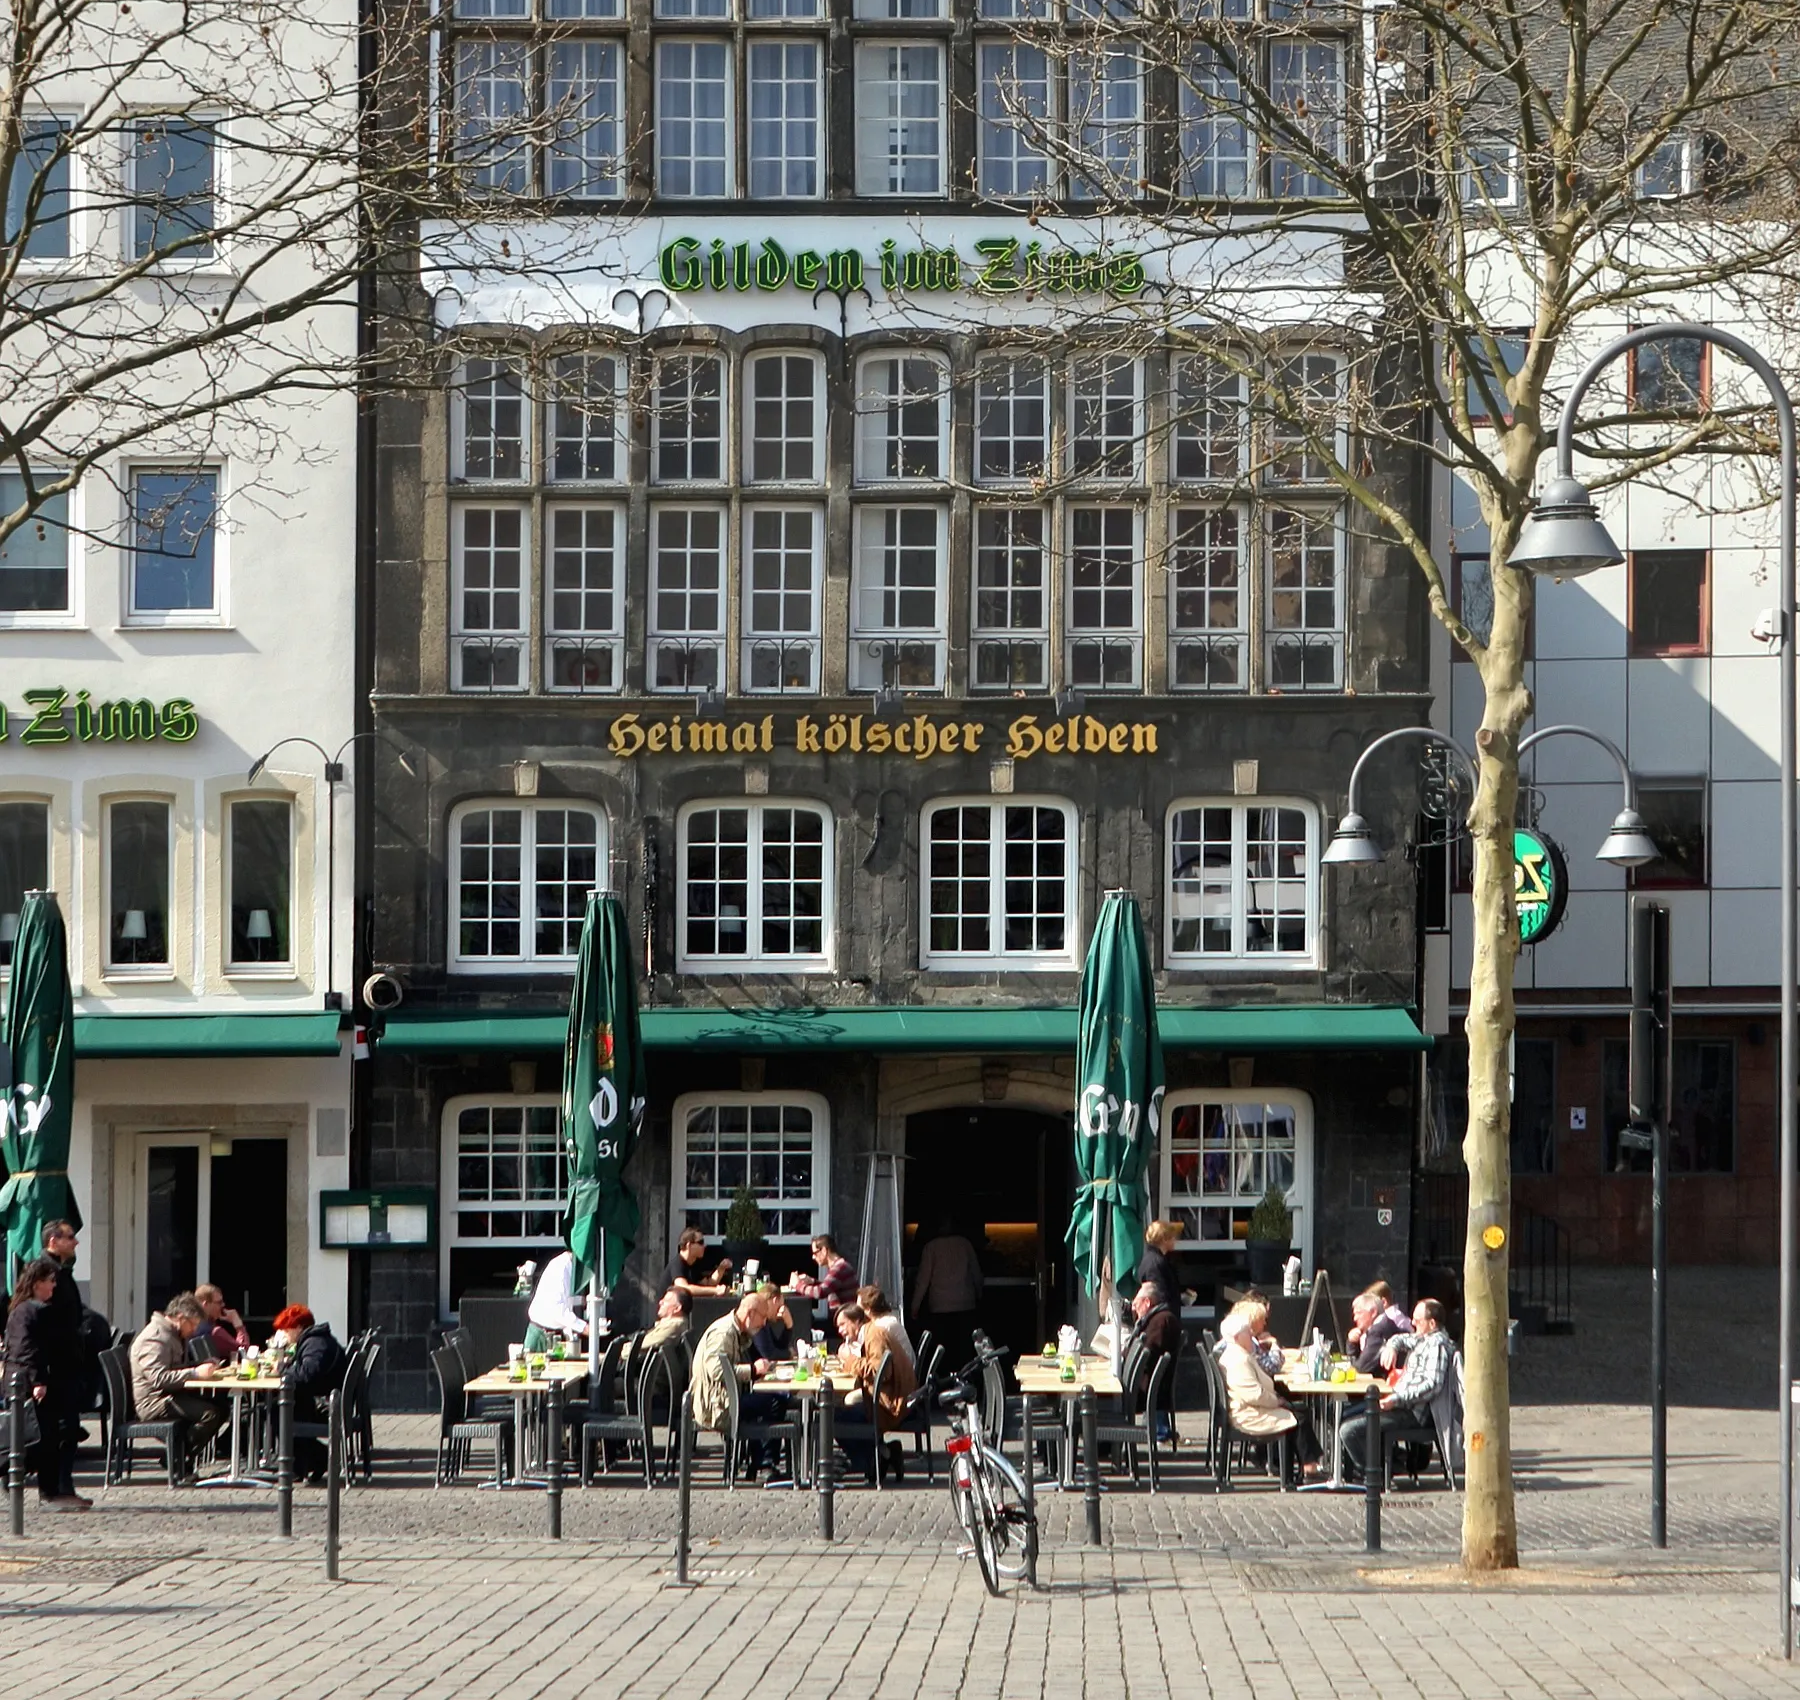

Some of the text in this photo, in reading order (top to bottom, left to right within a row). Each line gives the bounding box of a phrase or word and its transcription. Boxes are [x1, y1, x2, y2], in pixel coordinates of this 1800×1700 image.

[658, 235, 1148, 295] Gilden im Zims
[19, 684, 200, 744] Zims
[607, 711, 1159, 760] Heimat kölscher Helden
